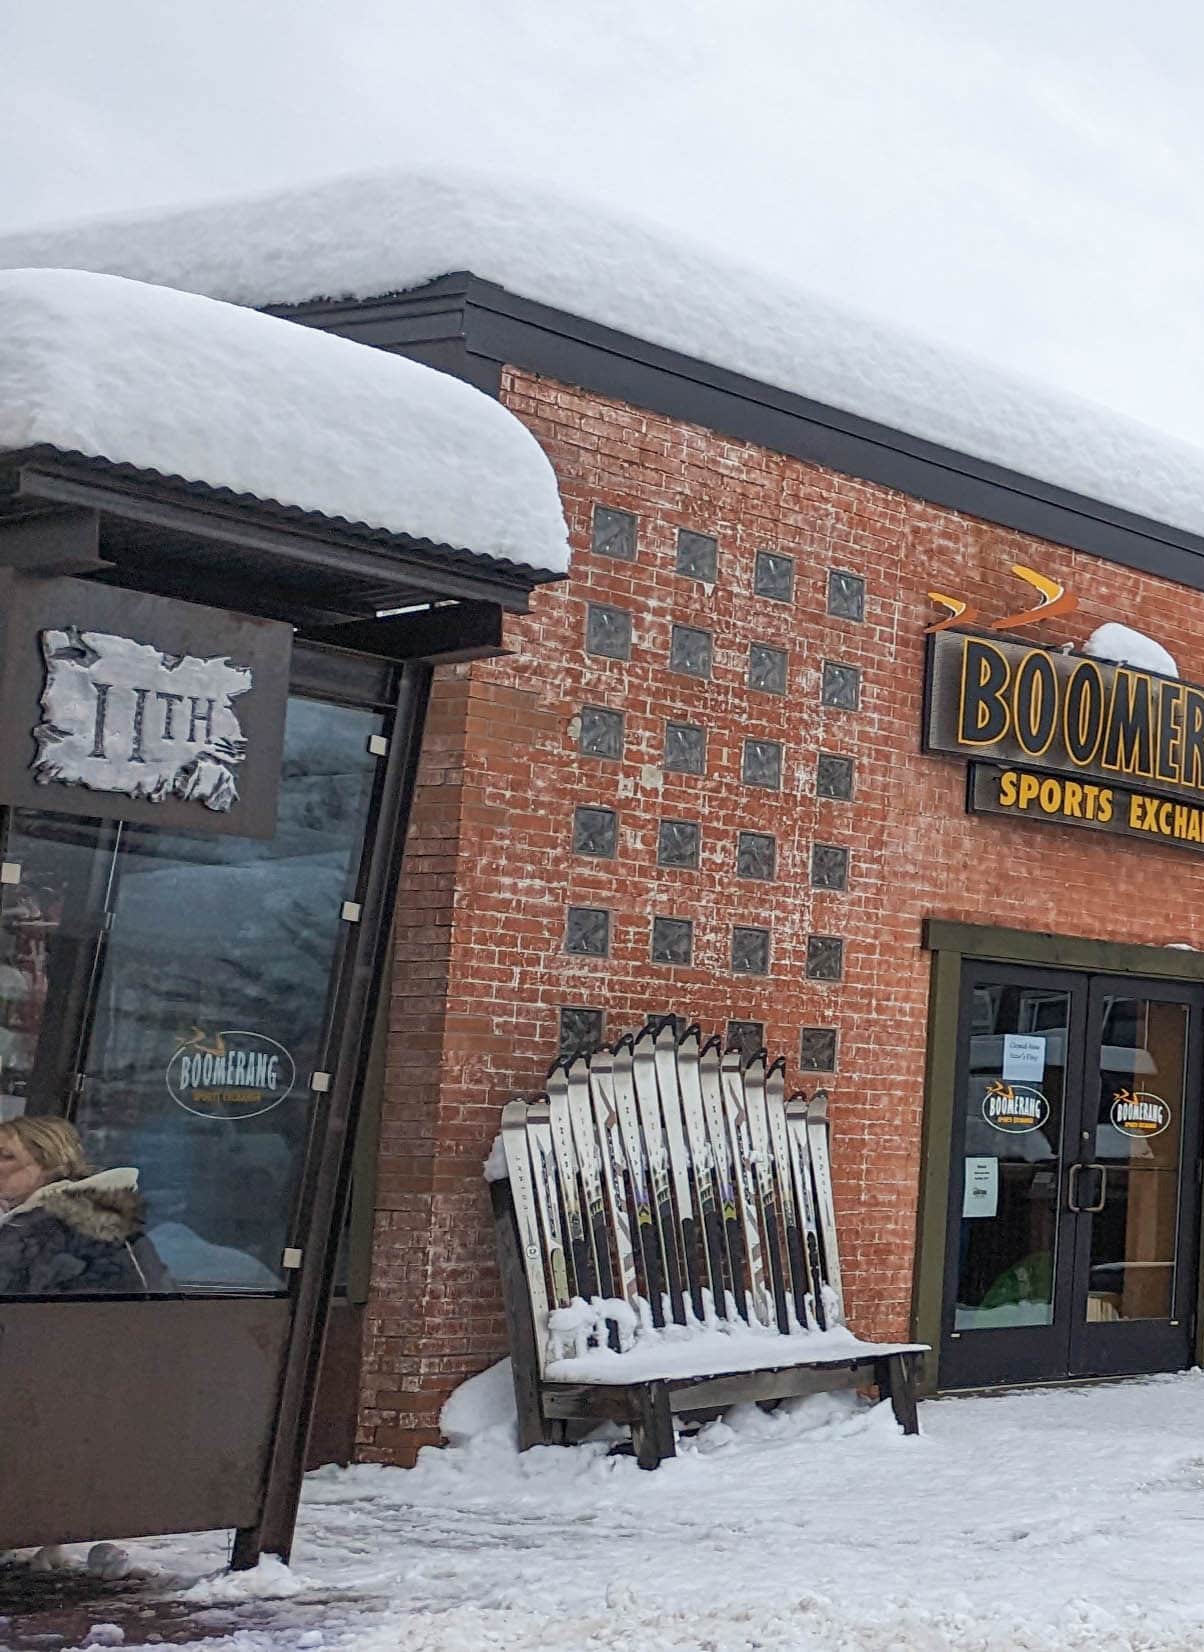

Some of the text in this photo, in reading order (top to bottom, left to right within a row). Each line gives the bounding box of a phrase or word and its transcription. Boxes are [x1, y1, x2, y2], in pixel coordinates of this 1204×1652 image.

[999, 771, 1114, 822] SPORTS
[179, 1050, 279, 1091] BOOMERANG
[989, 1095, 1041, 1119] BOOMERANG
[1116, 1102, 1164, 1125] BOOMERANG
